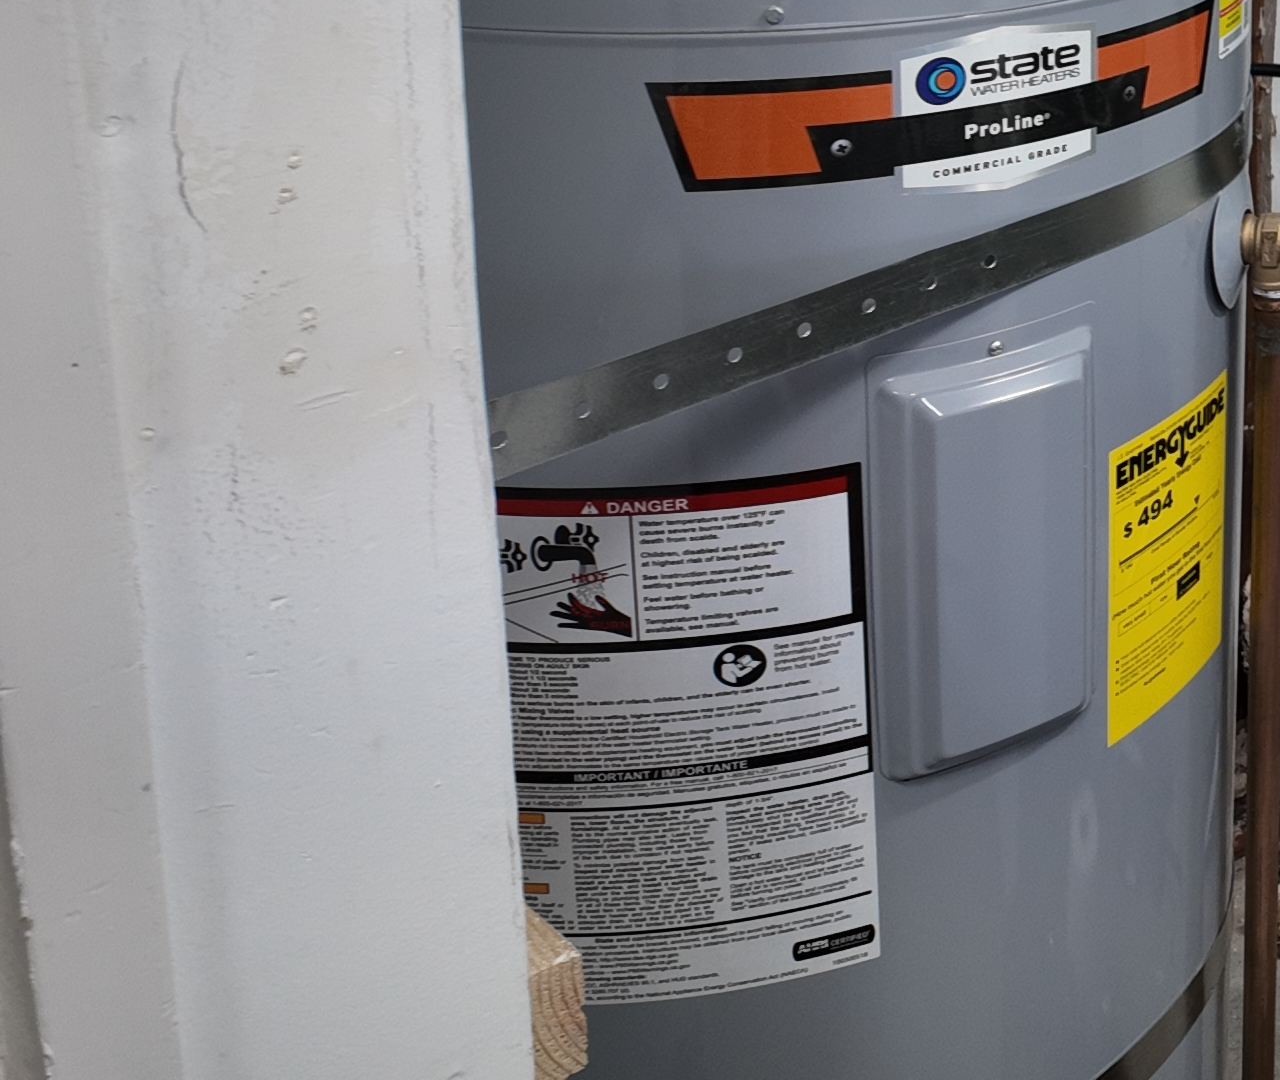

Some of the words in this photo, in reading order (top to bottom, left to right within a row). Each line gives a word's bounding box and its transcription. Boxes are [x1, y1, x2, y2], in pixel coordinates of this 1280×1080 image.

[970, 44, 1080, 84] state
[971, 79, 1019, 96] WATER
[1022, 67, 1080, 89] HEATERS
[933, 156, 1021, 178] COMMERCIAL
[1028, 144, 1068, 160] GRADE
[1115, 387, 1225, 489] ENERGYGUIDE
[606, 498, 689, 514] DANGER
[1123, 522, 1132, 538] $
[1138, 490, 1173, 526] 494
[666, 516, 718, 525] temperature
[668, 526, 696, 534] severe
[699, 524, 724, 532] burns
[727, 520, 763, 529] instantly
[667, 535, 686, 543] from
[682, 547, 719, 556] disabled
[740, 542, 769, 551] elderly
[652, 558, 684, 567] highest
[716, 553, 740, 562] being
[571, 572, 609, 584] HOT
[661, 570, 707, 579] instruction
[710, 567, 741, 575] manual
[744, 563, 771, 572] before
[642, 582, 672, 590] setting
[675, 578, 727, 588] temperature
[740, 573, 763, 581] water
[690, 592, 717, 600] before
[720, 588, 752, 598] bathing
[645, 615, 698, 625] Temperature
[701, 612, 733, 621] limiting
[736, 608, 762, 617] valves
[792, 638, 820, 647] manual
[835, 631, 854, 639] more
[774, 647, 818, 657] information
[819, 641, 841, 650] about
[774, 654, 815, 666] preventing
[817, 650, 839, 658] burns
[573, 770, 650, 782] IMPORTANT
[662, 760, 748, 778] IMPORTANTE
[729, 853, 761, 862] NOTICE
